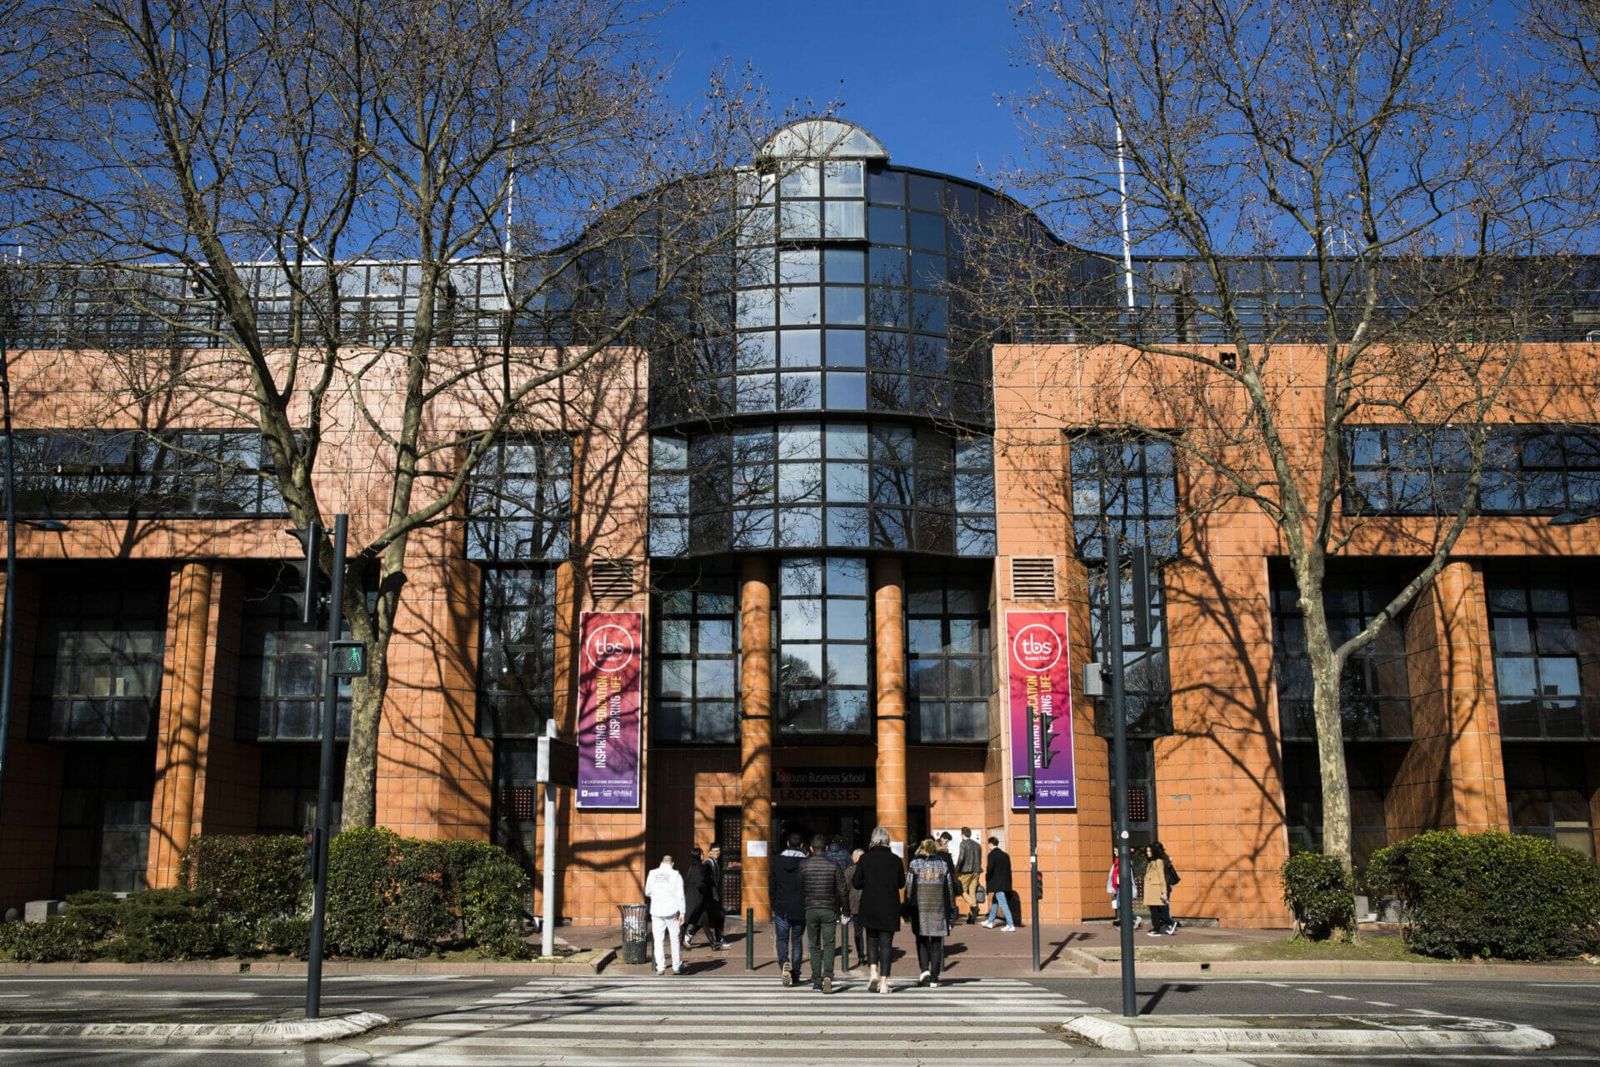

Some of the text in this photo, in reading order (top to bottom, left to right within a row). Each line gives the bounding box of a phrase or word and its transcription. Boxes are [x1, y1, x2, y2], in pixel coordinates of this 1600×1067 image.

[594, 633, 624, 655] tbs
[1022, 633, 1052, 655] tbs
[1040, 675, 1052, 693] LIFE
[609, 676, 621, 738] INSPIRING LIFE
[594, 676, 607, 768] INSPIRING EDUCATION
[841, 772, 866, 784] School
